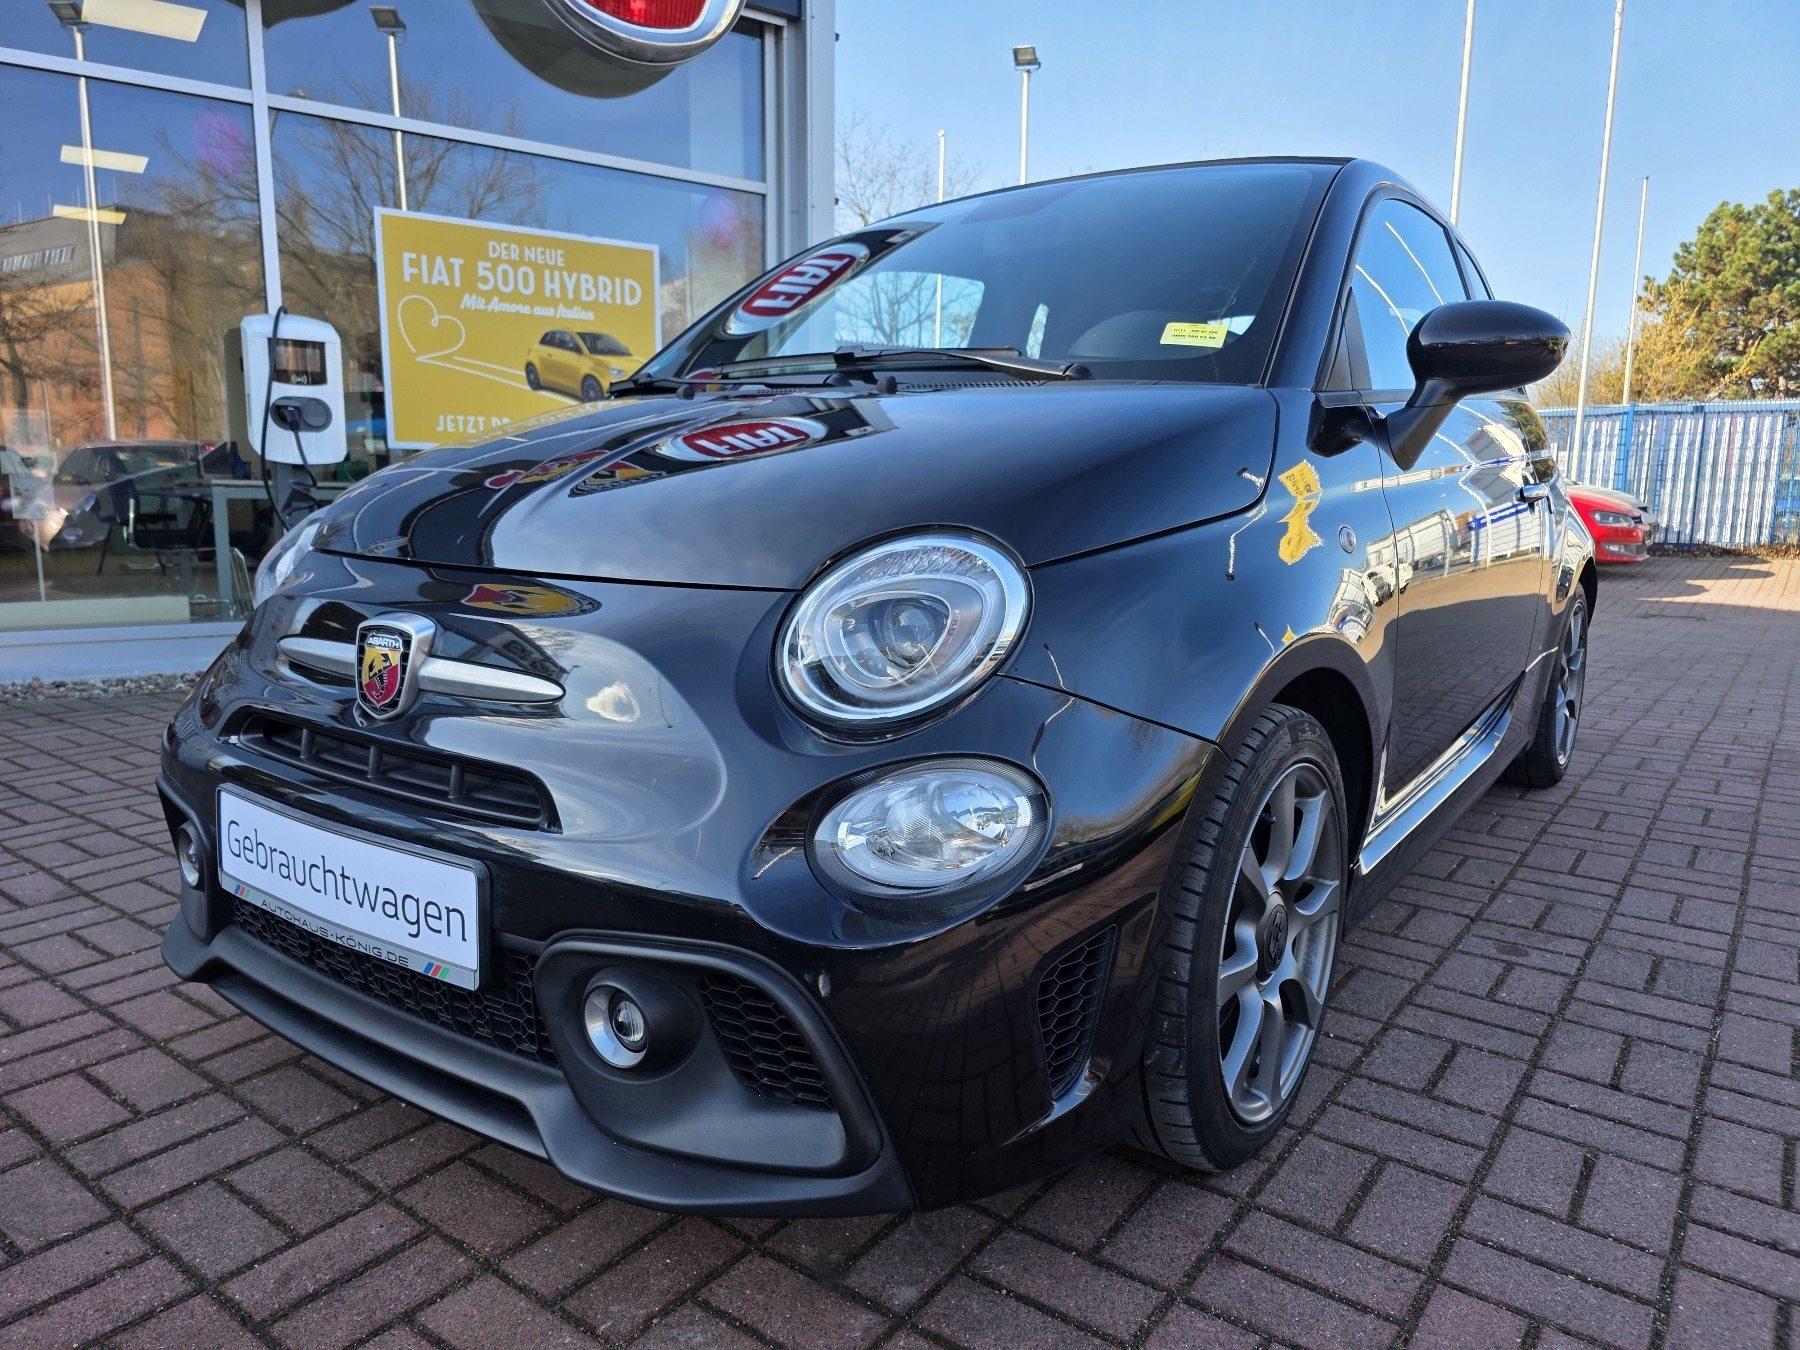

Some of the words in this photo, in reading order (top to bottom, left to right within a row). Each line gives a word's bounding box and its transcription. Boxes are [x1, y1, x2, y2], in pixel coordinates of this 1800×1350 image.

[488, 241, 519, 261] DER
[524, 246, 565, 267] NEUE
[403, 252, 464, 288] FIAT
[477, 261, 535, 296] 500
[544, 269, 642, 306] HYBRID
[460, 293, 486, 310] Mit
[487, 296, 531, 314] Amore
[533, 304, 555, 317] aus
[556, 303, 595, 320] Italien
[436, 415, 484, 432] JETZT
[367, 636, 400, 648] ABARTH
[227, 820, 468, 942] Gebrauchtwagen
[260, 899, 409, 967] AUTOHAUS-KÖNIG.DE
